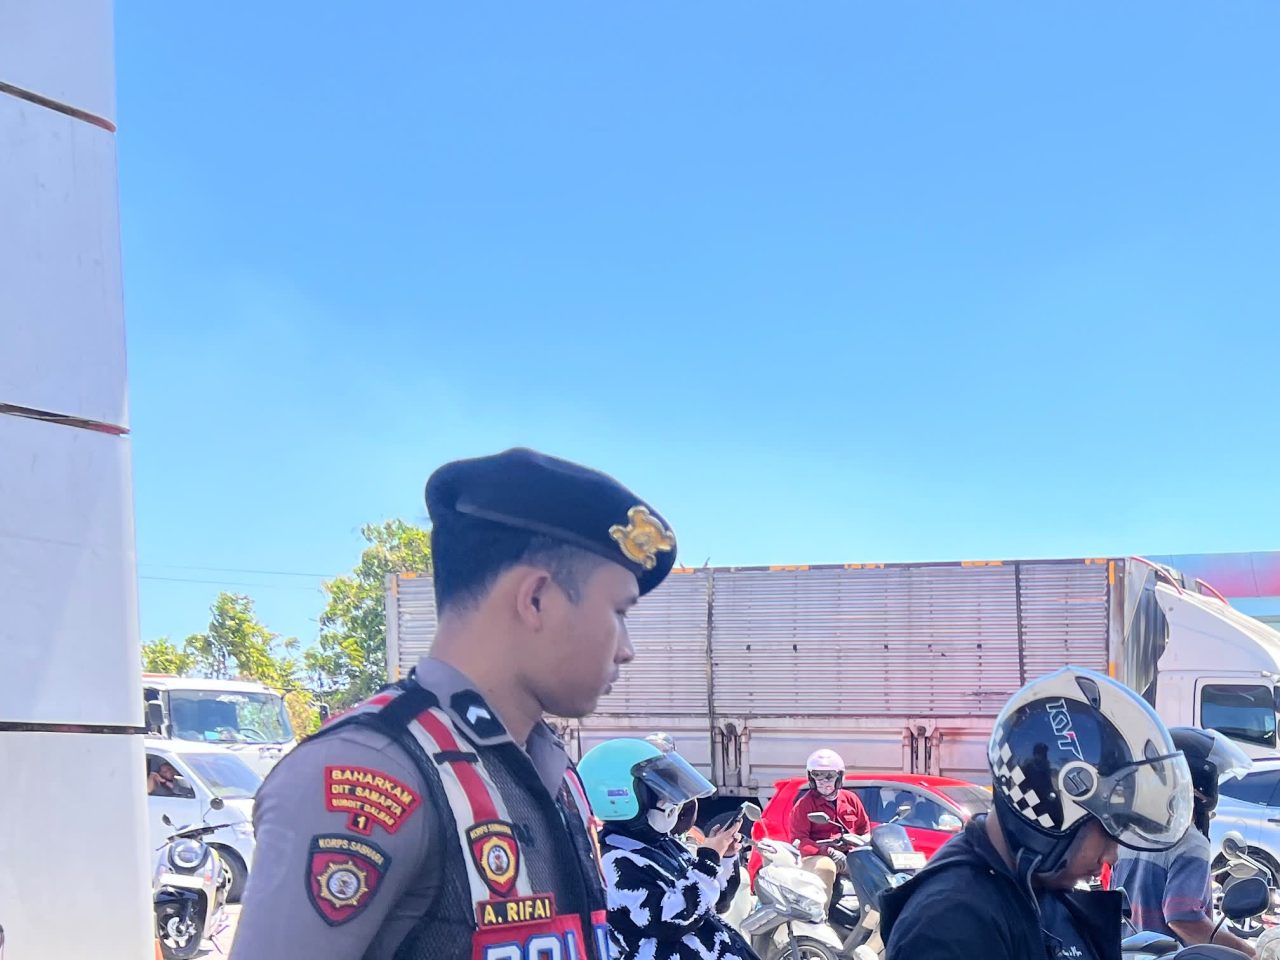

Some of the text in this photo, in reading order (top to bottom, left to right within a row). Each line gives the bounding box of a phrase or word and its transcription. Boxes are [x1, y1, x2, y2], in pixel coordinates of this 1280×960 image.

[1045, 698, 1085, 761] KYT
[331, 769, 413, 805] BAHARKAM
[331, 784, 402, 817] DIT SAMAPTA
[357, 815, 367, 830] 1
[318, 838, 349, 849] KORPS
[484, 898, 551, 924] A. RIFAI
